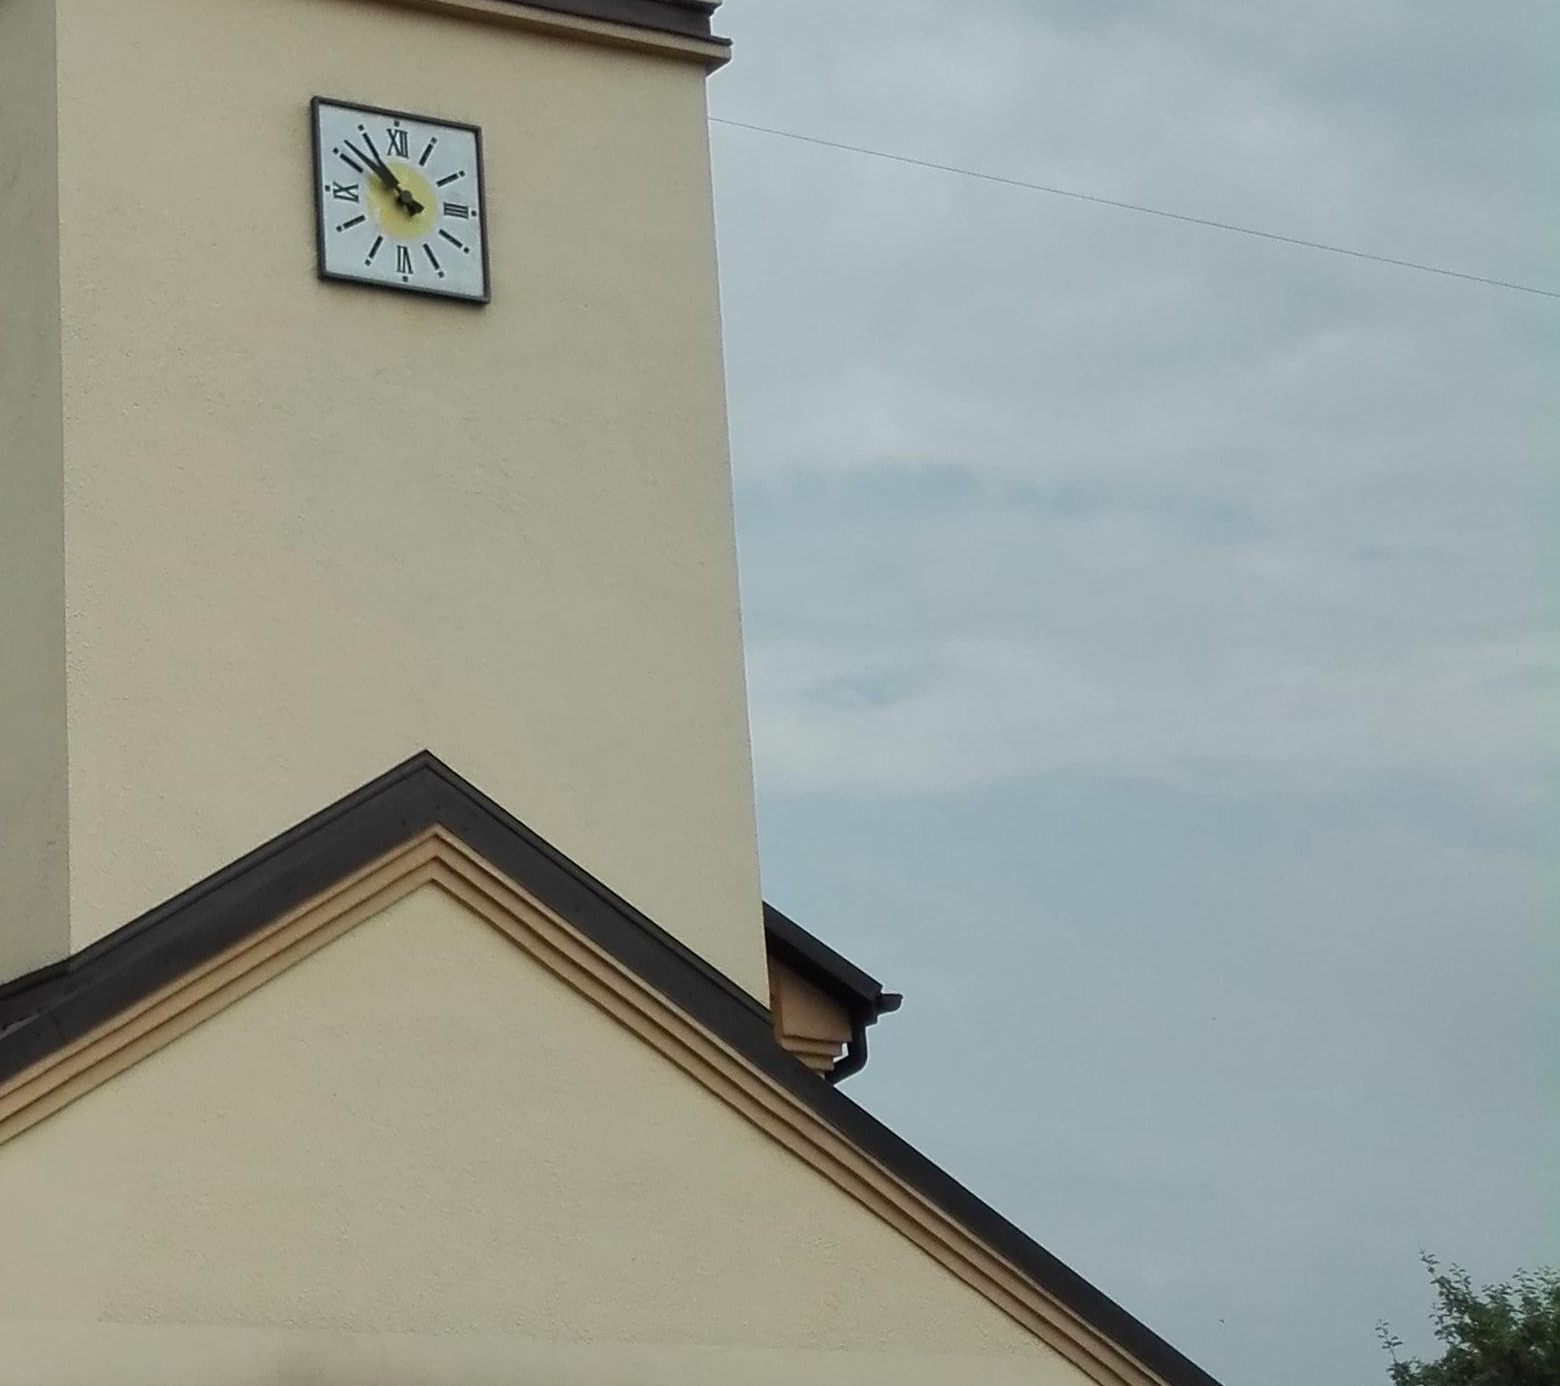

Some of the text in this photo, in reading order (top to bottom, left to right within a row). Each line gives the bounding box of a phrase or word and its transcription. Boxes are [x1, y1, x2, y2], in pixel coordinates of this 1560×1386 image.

[386, 127, 410, 160] XII
[332, 180, 360, 203] IX
[443, 201, 470, 220] III
[396, 245, 414, 275] VI
